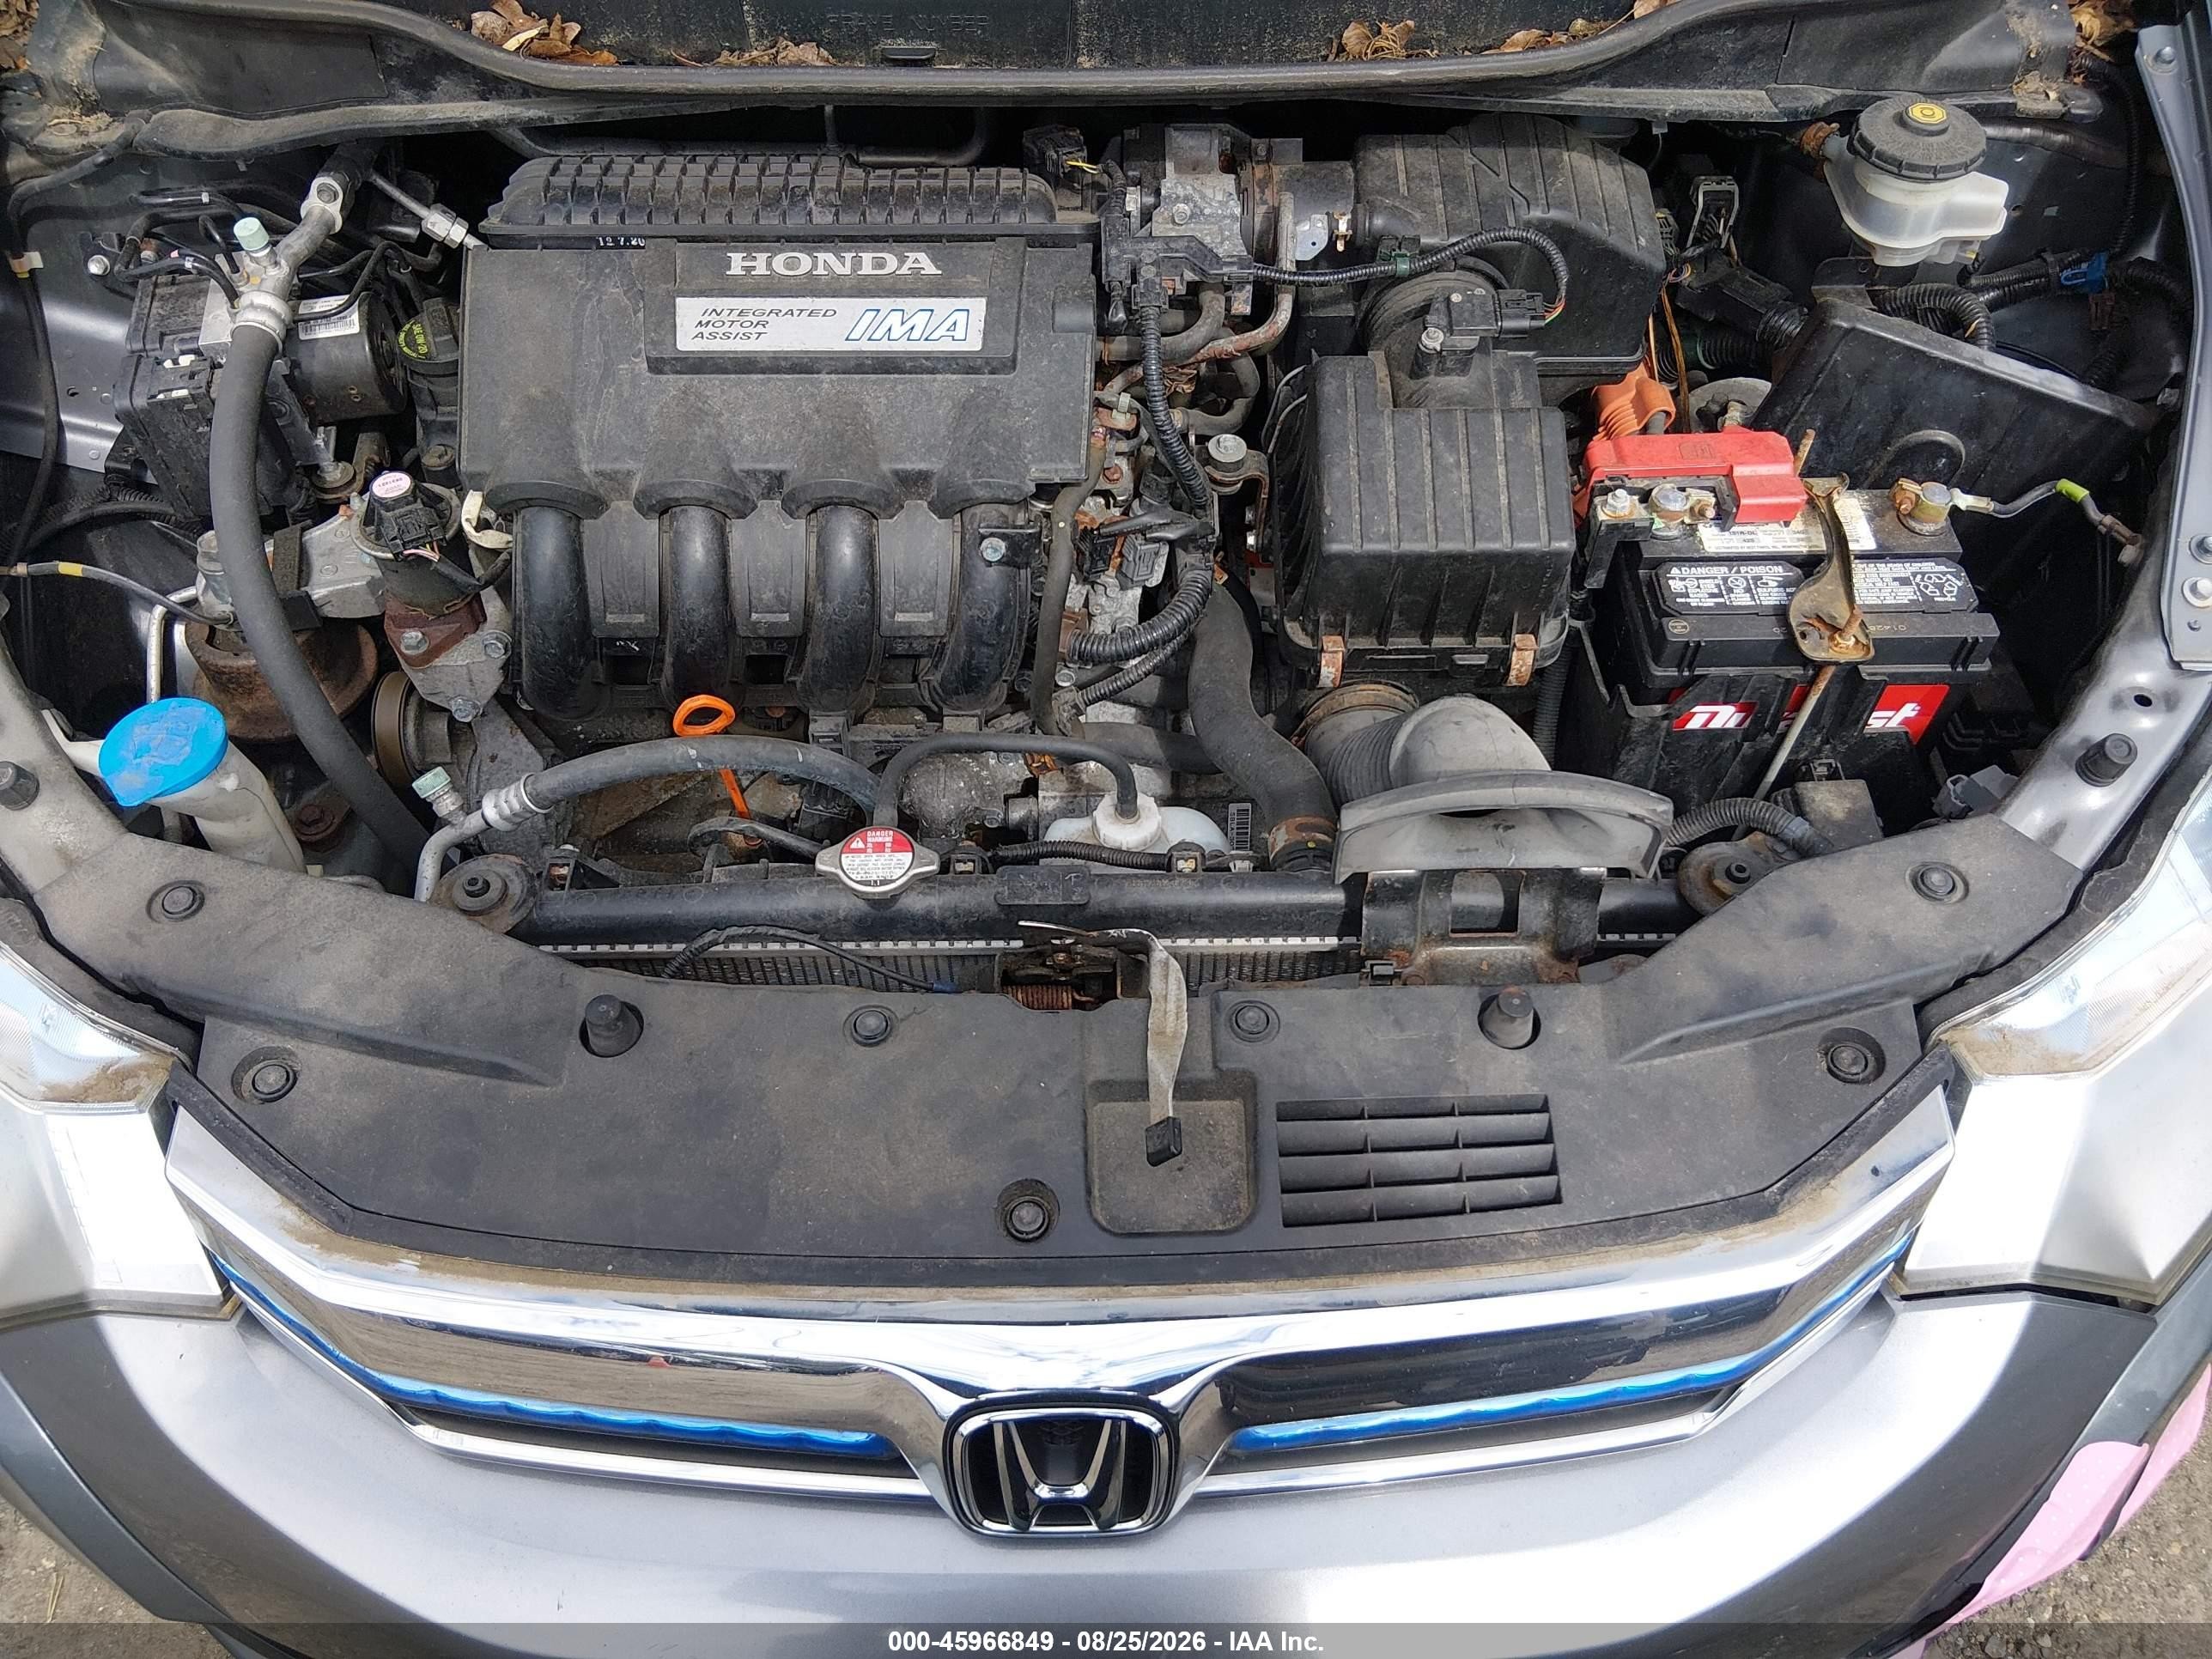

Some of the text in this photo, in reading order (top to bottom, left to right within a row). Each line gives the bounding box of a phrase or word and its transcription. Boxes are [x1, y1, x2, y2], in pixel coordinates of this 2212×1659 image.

[726, 252, 942, 276] HONDA
[701, 308, 837, 318] INTEGRATED
[695, 320, 769, 329] MOTOR
[845, 309, 970, 342] IMA
[691, 331, 769, 341] ASSIST
